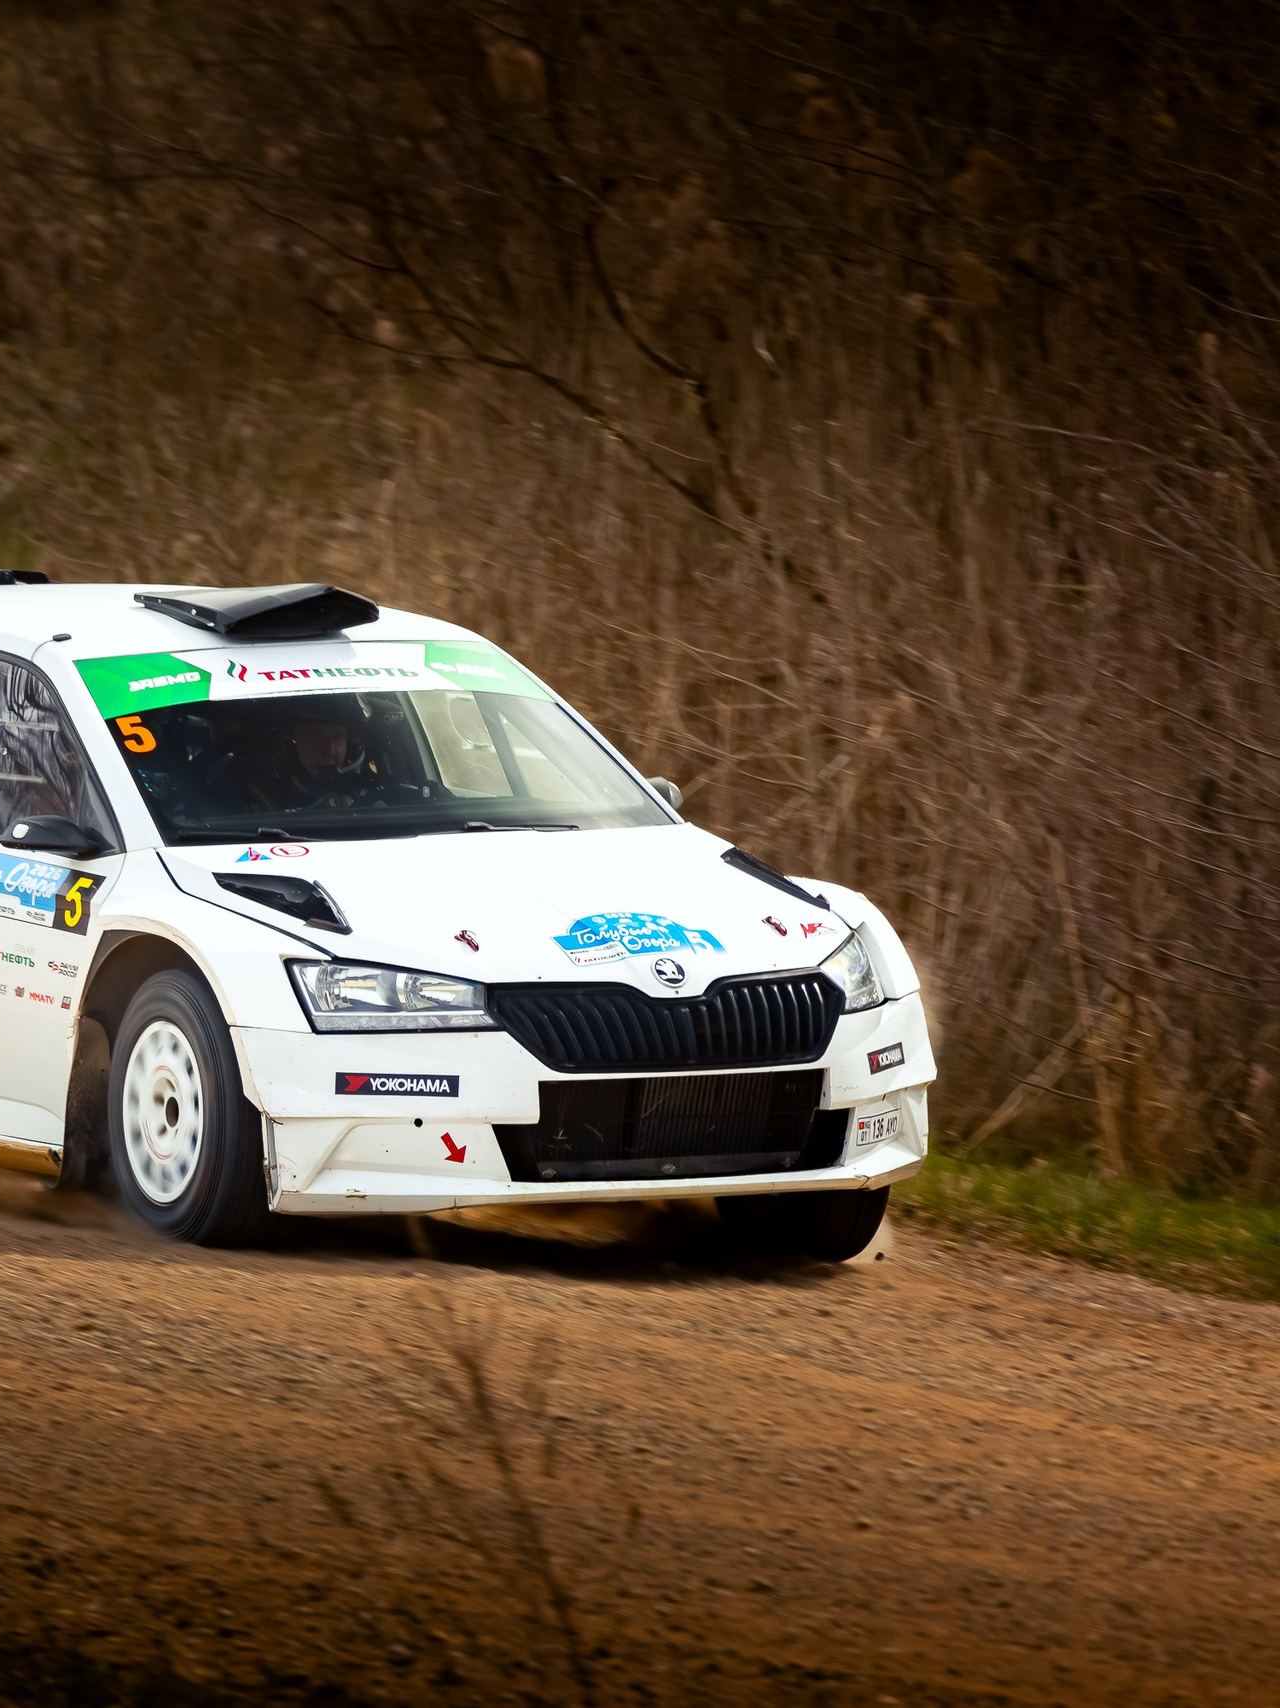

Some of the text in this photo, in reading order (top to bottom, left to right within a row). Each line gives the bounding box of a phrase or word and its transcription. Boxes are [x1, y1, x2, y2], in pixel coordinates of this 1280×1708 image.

[257, 667, 419, 681] ТАТНЕФТЬ
[115, 715, 157, 753] 5
[64, 876, 94, 928] 5
[369, 1077, 451, 1093] YOKOHAMA
[873, 1117, 884, 1140] 136
